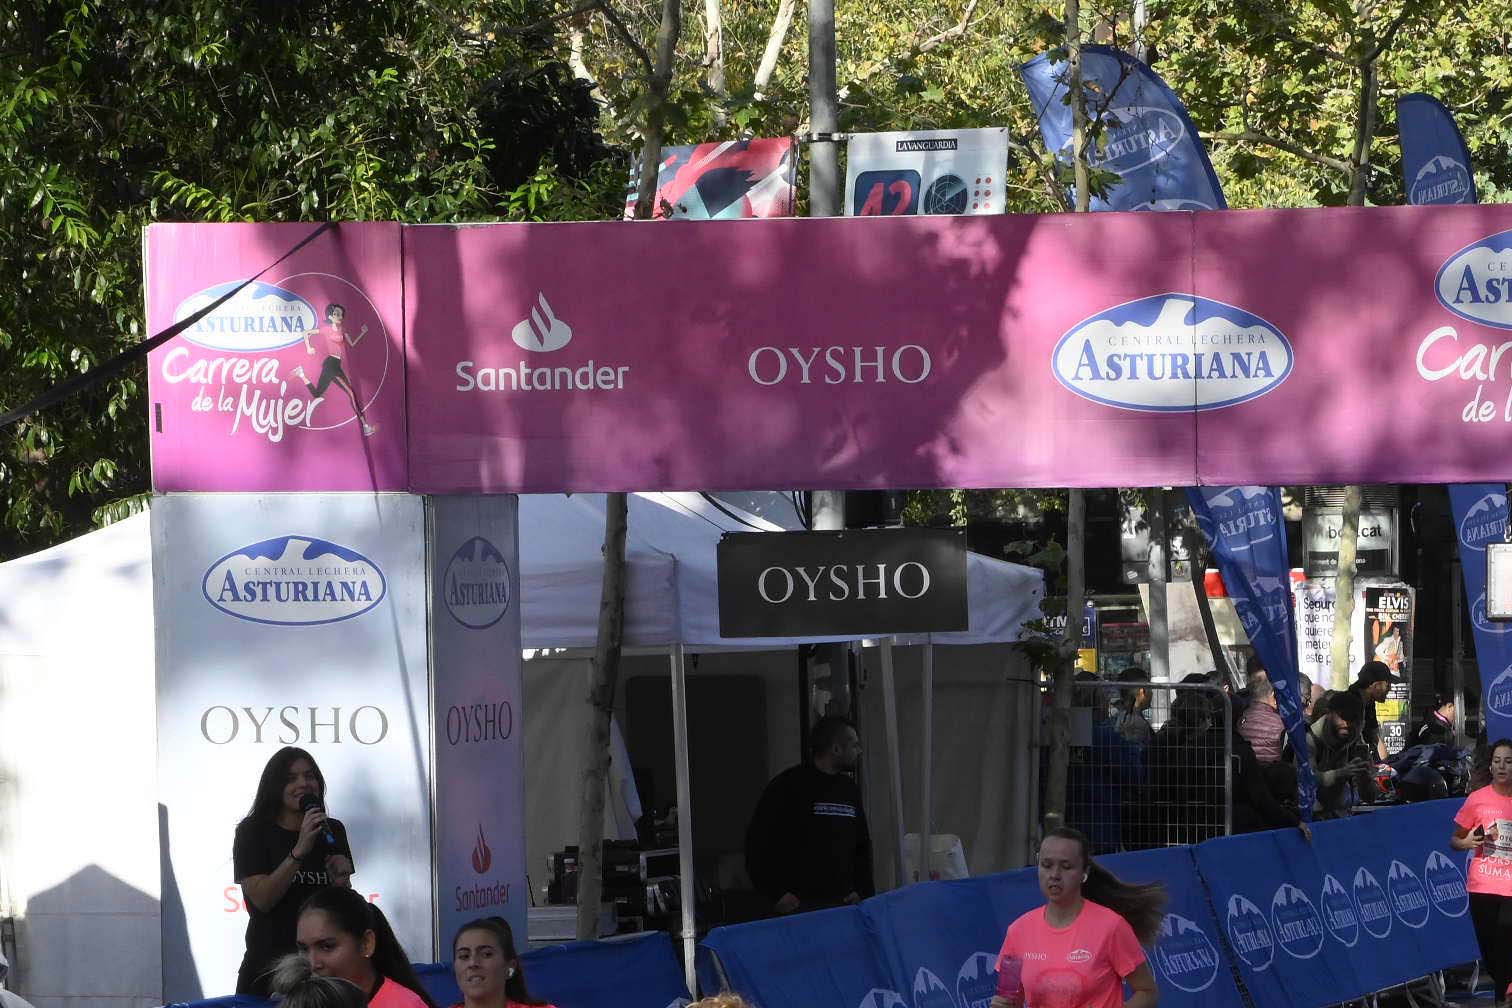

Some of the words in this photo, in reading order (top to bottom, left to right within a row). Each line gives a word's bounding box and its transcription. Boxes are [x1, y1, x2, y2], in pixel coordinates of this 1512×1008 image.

[1108, 335, 1186, 346] CENTRAL
[1190, 333, 1267, 345] LECHERA
[162, 347, 281, 384] Carrera
[456, 360, 630, 392] Santander
[748, 344, 932, 385] OYSHO
[1071, 338, 1275, 382] ASTURIANA
[191, 391, 214, 412] de
[217, 391, 234, 412] la
[230, 381, 324, 442] Mujer
[1461, 384, 1497, 422] de
[217, 568, 373, 604] ASTURIANA
[244, 567, 304, 577] CENTRAL
[308, 566, 367, 577] LECHERA
[449, 571, 507, 606] ASTURIANA
[758, 562, 932, 604] OYSHO
[1378, 596, 1409, 609] ELVIS
[199, 704, 389, 746] OYSHO
[446, 700, 513, 747] OYSHO
[1478, 864, 1511, 878] SUMA
[455, 883, 511, 913] Santander
